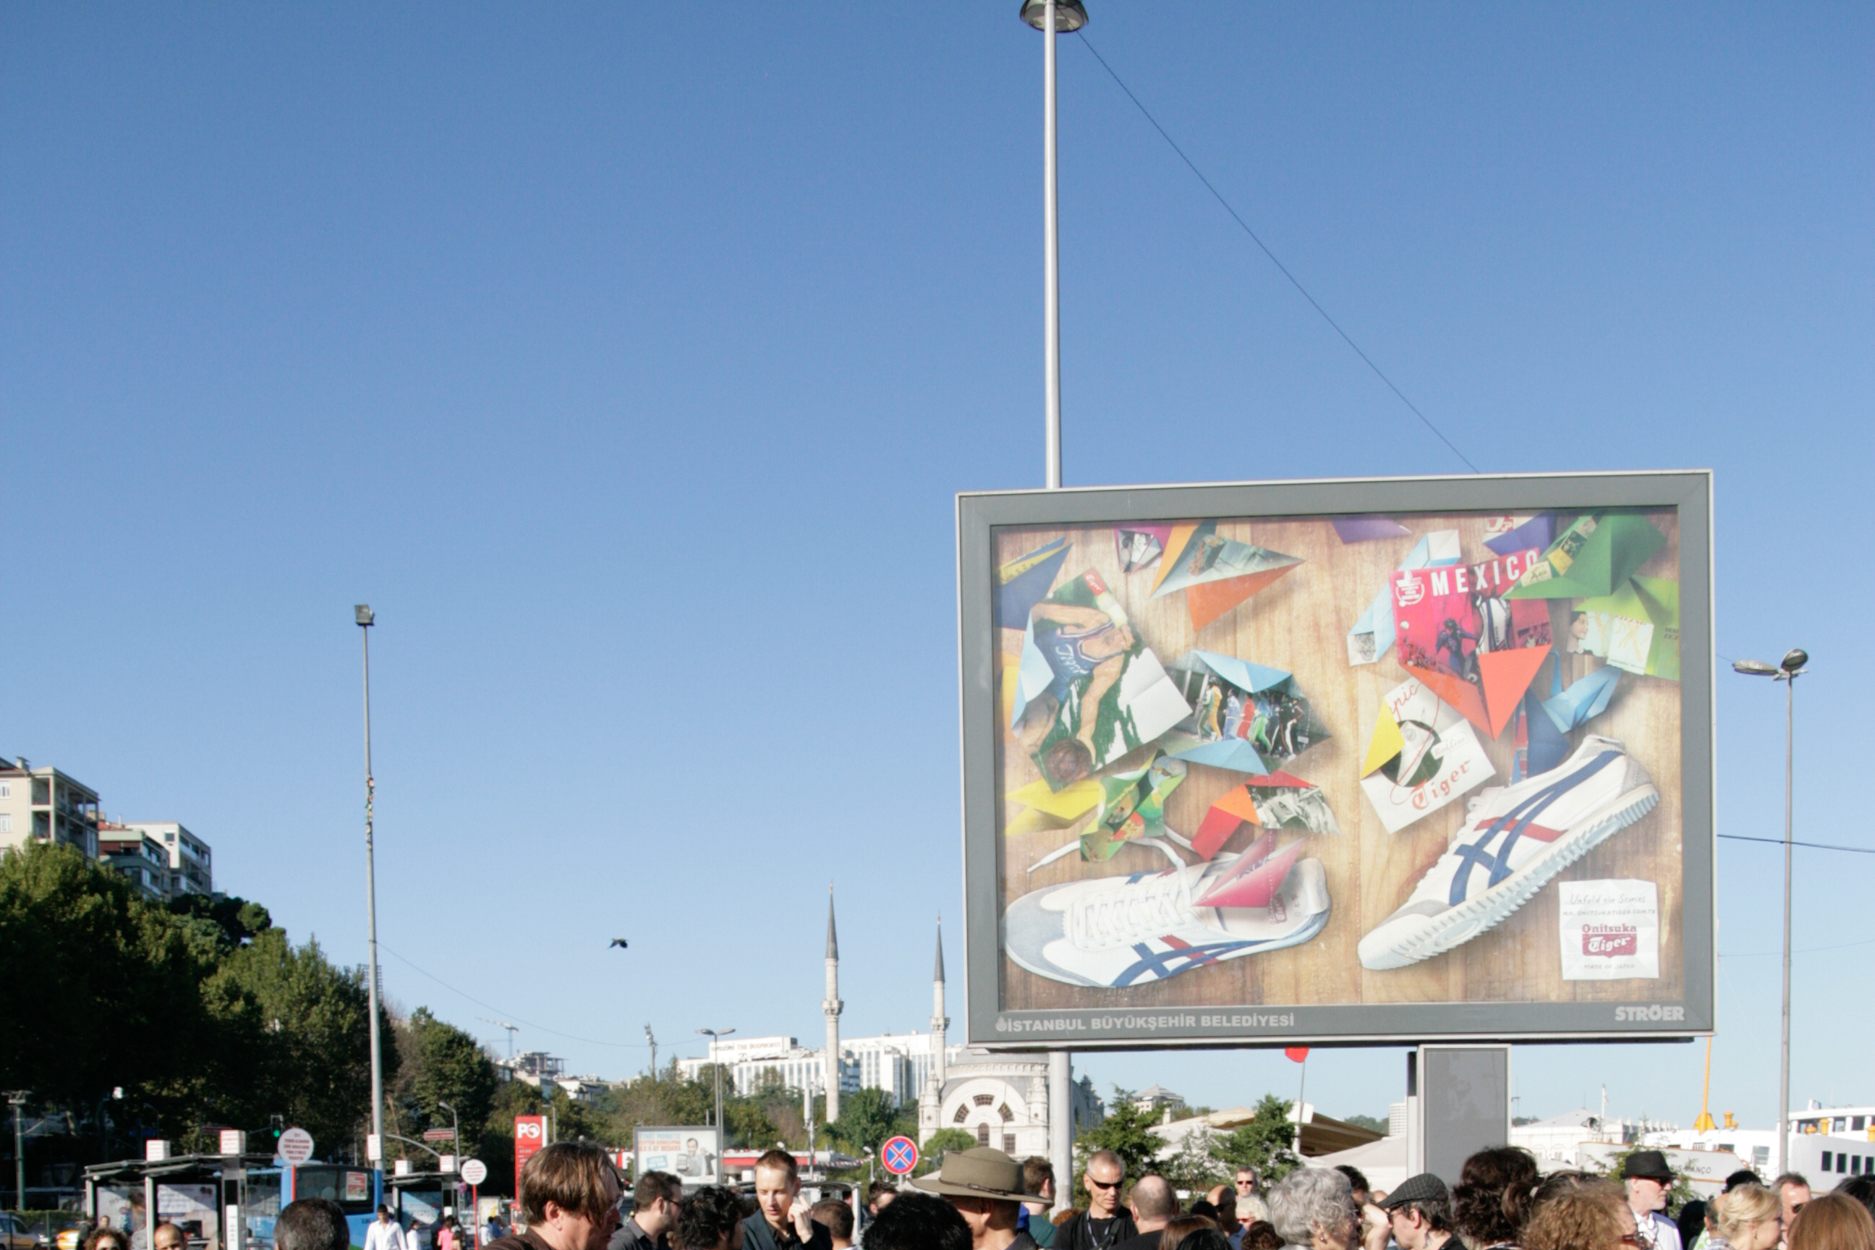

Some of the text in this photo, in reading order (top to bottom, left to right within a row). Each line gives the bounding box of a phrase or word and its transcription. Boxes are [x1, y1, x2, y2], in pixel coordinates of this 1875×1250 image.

[1410, 758, 1471, 811] Tiger
[1570, 893, 1602, 906] Unfold
[1618, 892, 1647, 904] Stories
[1582, 923, 1637, 933] Onitsuka
[1588, 936, 1631, 953] Tiger
[1615, 1004, 1685, 1021] STRÖER
[1008, 1012, 1295, 1033] İSTANBUL BÜYÜKŞEHİR BELEDİYESİ
